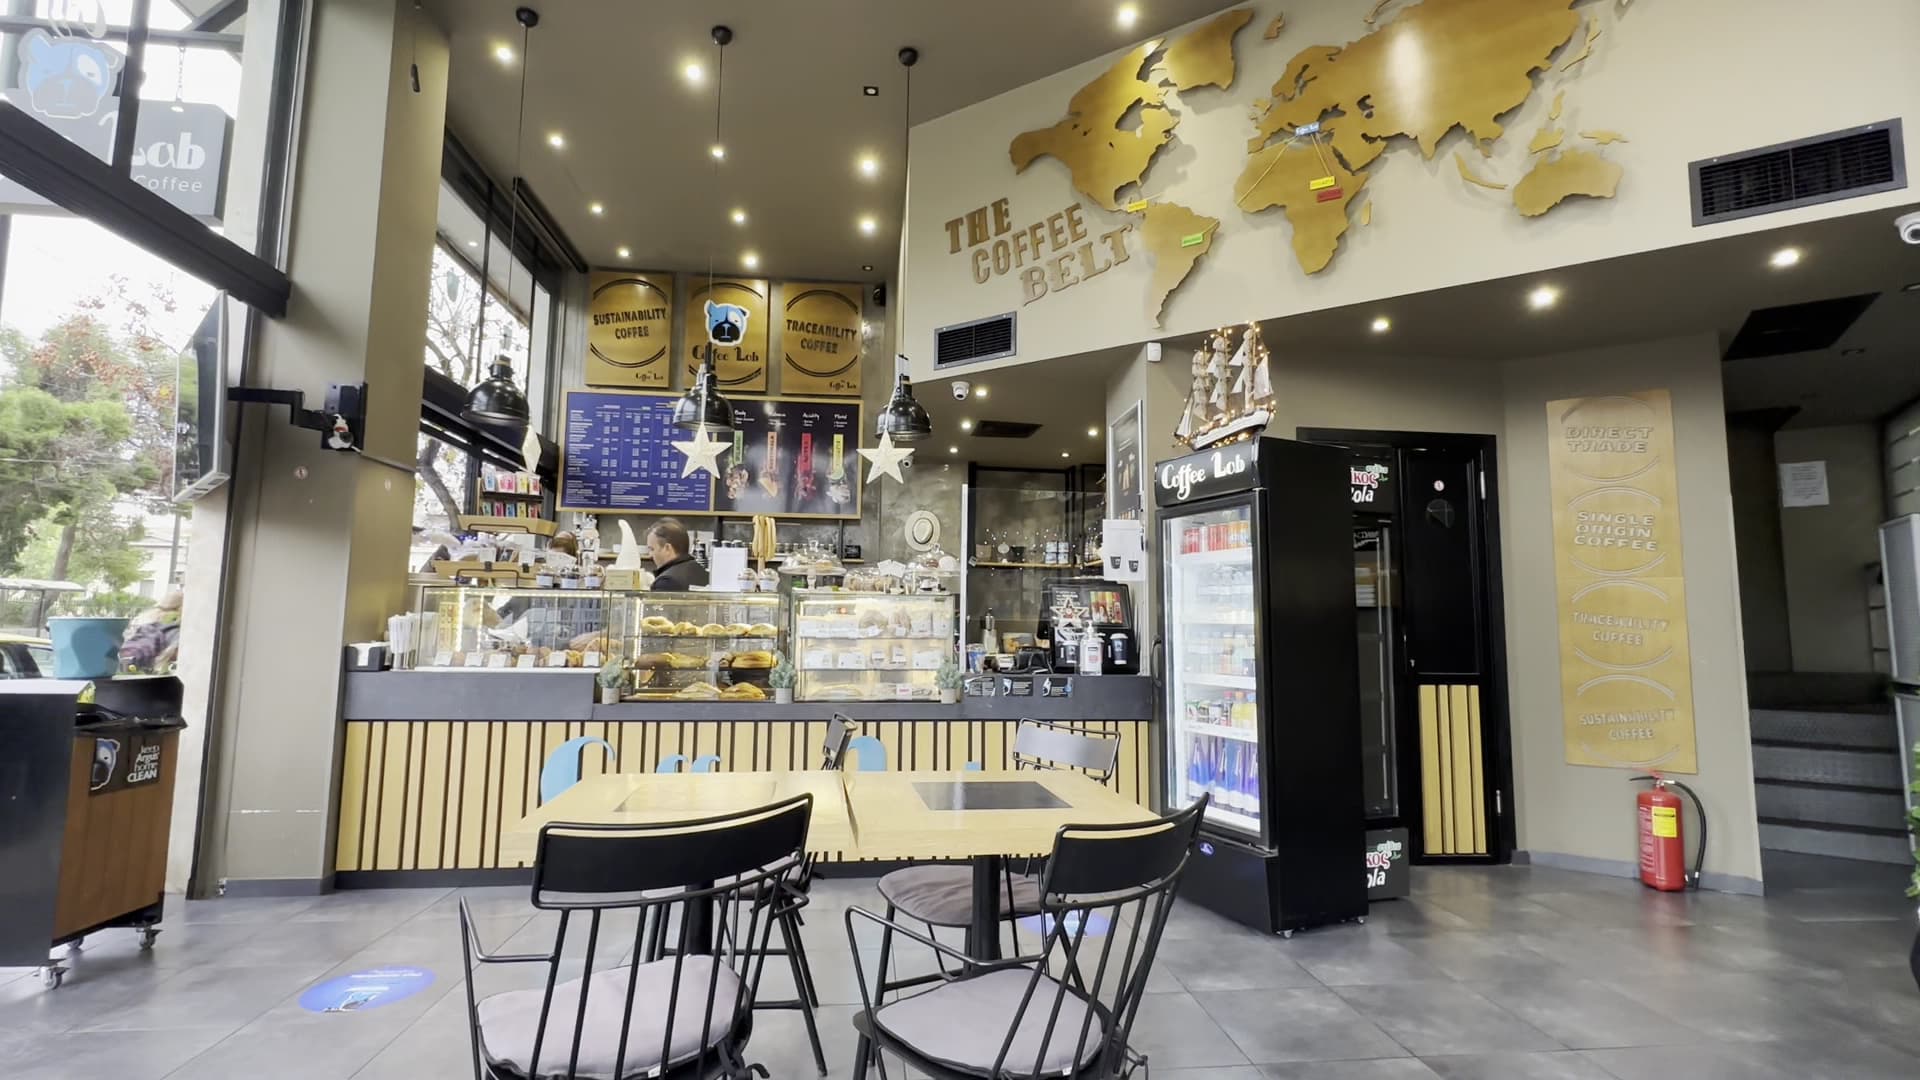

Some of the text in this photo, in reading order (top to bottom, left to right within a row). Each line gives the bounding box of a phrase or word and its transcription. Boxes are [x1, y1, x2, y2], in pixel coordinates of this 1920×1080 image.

[945, 197, 1011, 254] THE
[971, 203, 1088, 284] COFFEE
[1019, 224, 1134, 307] BELT
[593, 308, 667, 326] SUSTAINABILITY
[615, 326, 650, 340] COFFEE
[786, 319, 858, 340] TRACEABILITY
[800, 338, 838, 354] COFFEE
[1566, 426, 1654, 440] DIRECT
[1567, 440, 1649, 453] TRADE
[1161, 451, 1246, 500] Coffee Lab
[1577, 511, 1656, 526] SINGLE
[1576, 524, 1651, 537] ORIGIN
[1574, 535, 1657, 551] COFFEE
[1573, 612, 1670, 631] TRACEABILITY
[1593, 630, 1643, 645] COFFEE
[1608, 729, 1654, 740] COFFEE
[127, 769, 157, 783] CLEAN
